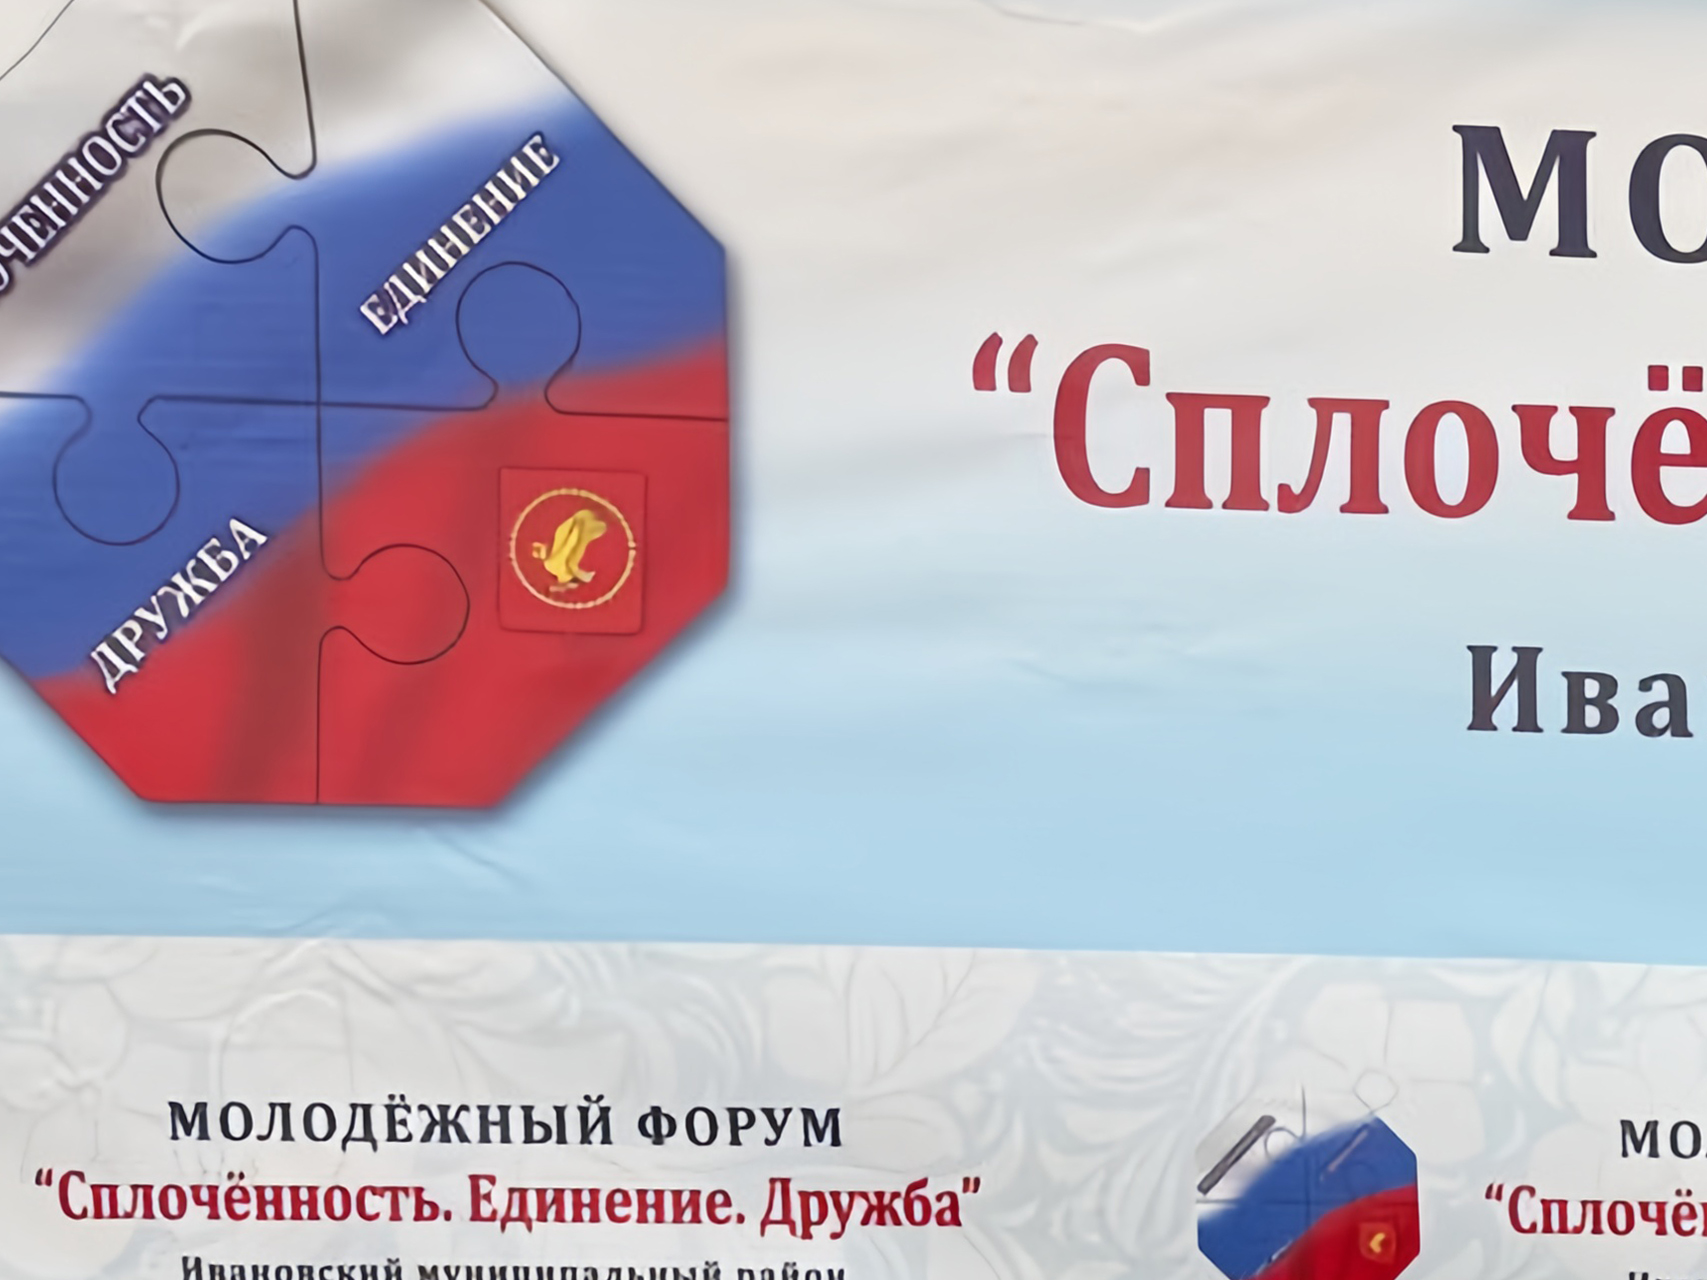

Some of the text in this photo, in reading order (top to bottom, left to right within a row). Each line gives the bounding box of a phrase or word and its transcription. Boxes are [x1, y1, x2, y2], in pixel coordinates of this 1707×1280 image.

[360, 133, 560, 334] ЕДИНЕНИЕ
[90, 518, 268, 693] ДРУЖБА
[168, 1094, 841, 1152] МОЛОДЁЖНЫЙ ФОРУМ
[468, 1174, 745, 1233] Единение.
